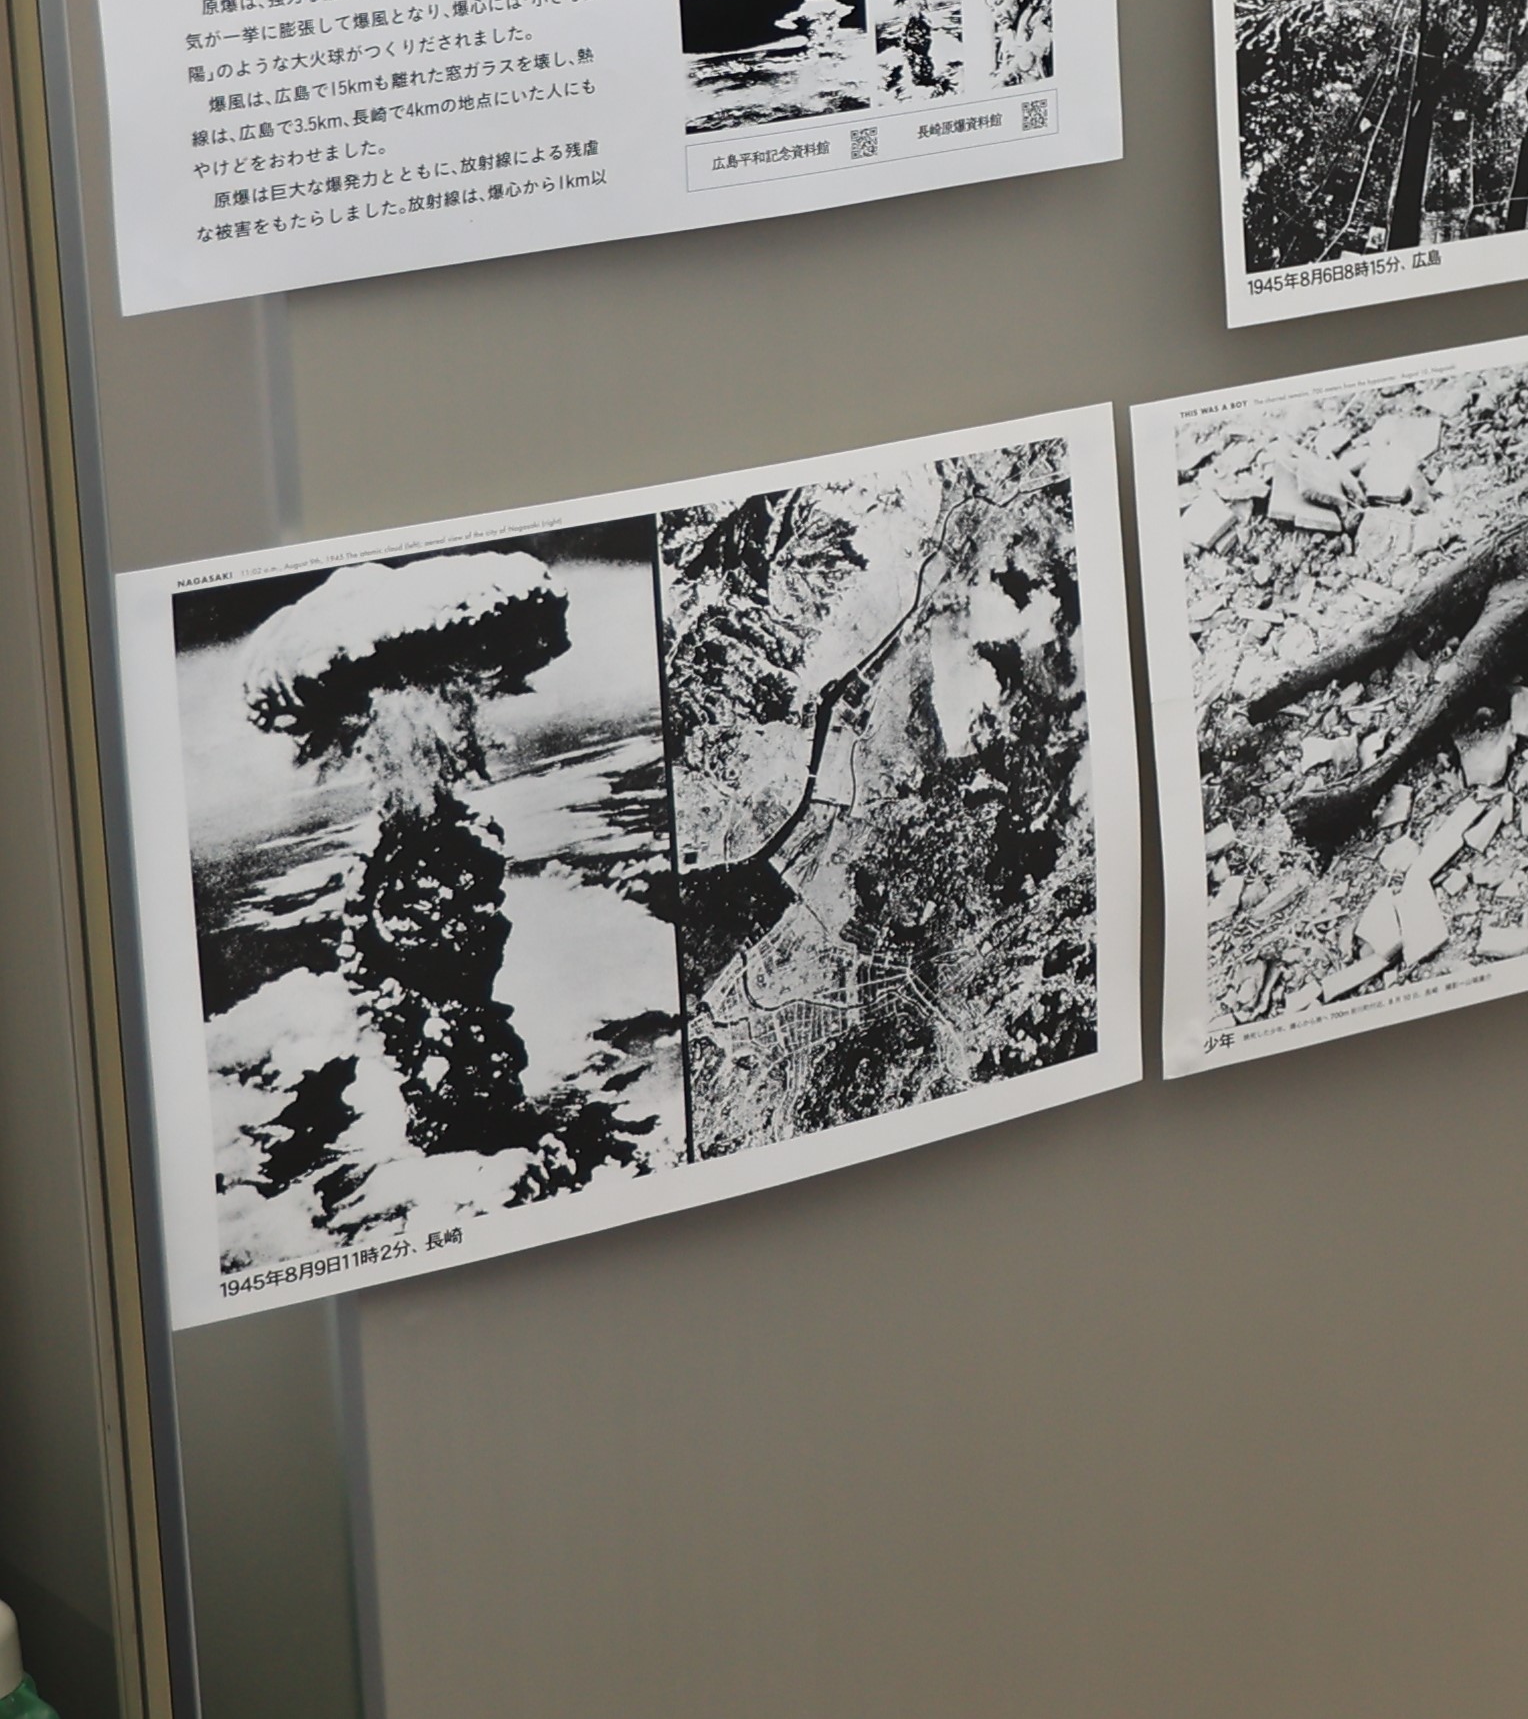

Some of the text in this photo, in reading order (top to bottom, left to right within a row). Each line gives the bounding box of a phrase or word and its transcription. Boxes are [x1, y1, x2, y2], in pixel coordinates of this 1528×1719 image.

[193, 140, 388, 179] やけどをおわせました。
[1247, 248, 1442, 297] 1945年8月6日8時15分、広島
[177, 572, 234, 588] NAGASAKI
[1203, 1031, 1236, 1056] 少年
[219, 1226, 464, 1299] 1945年8月9日11時2分、長崎
